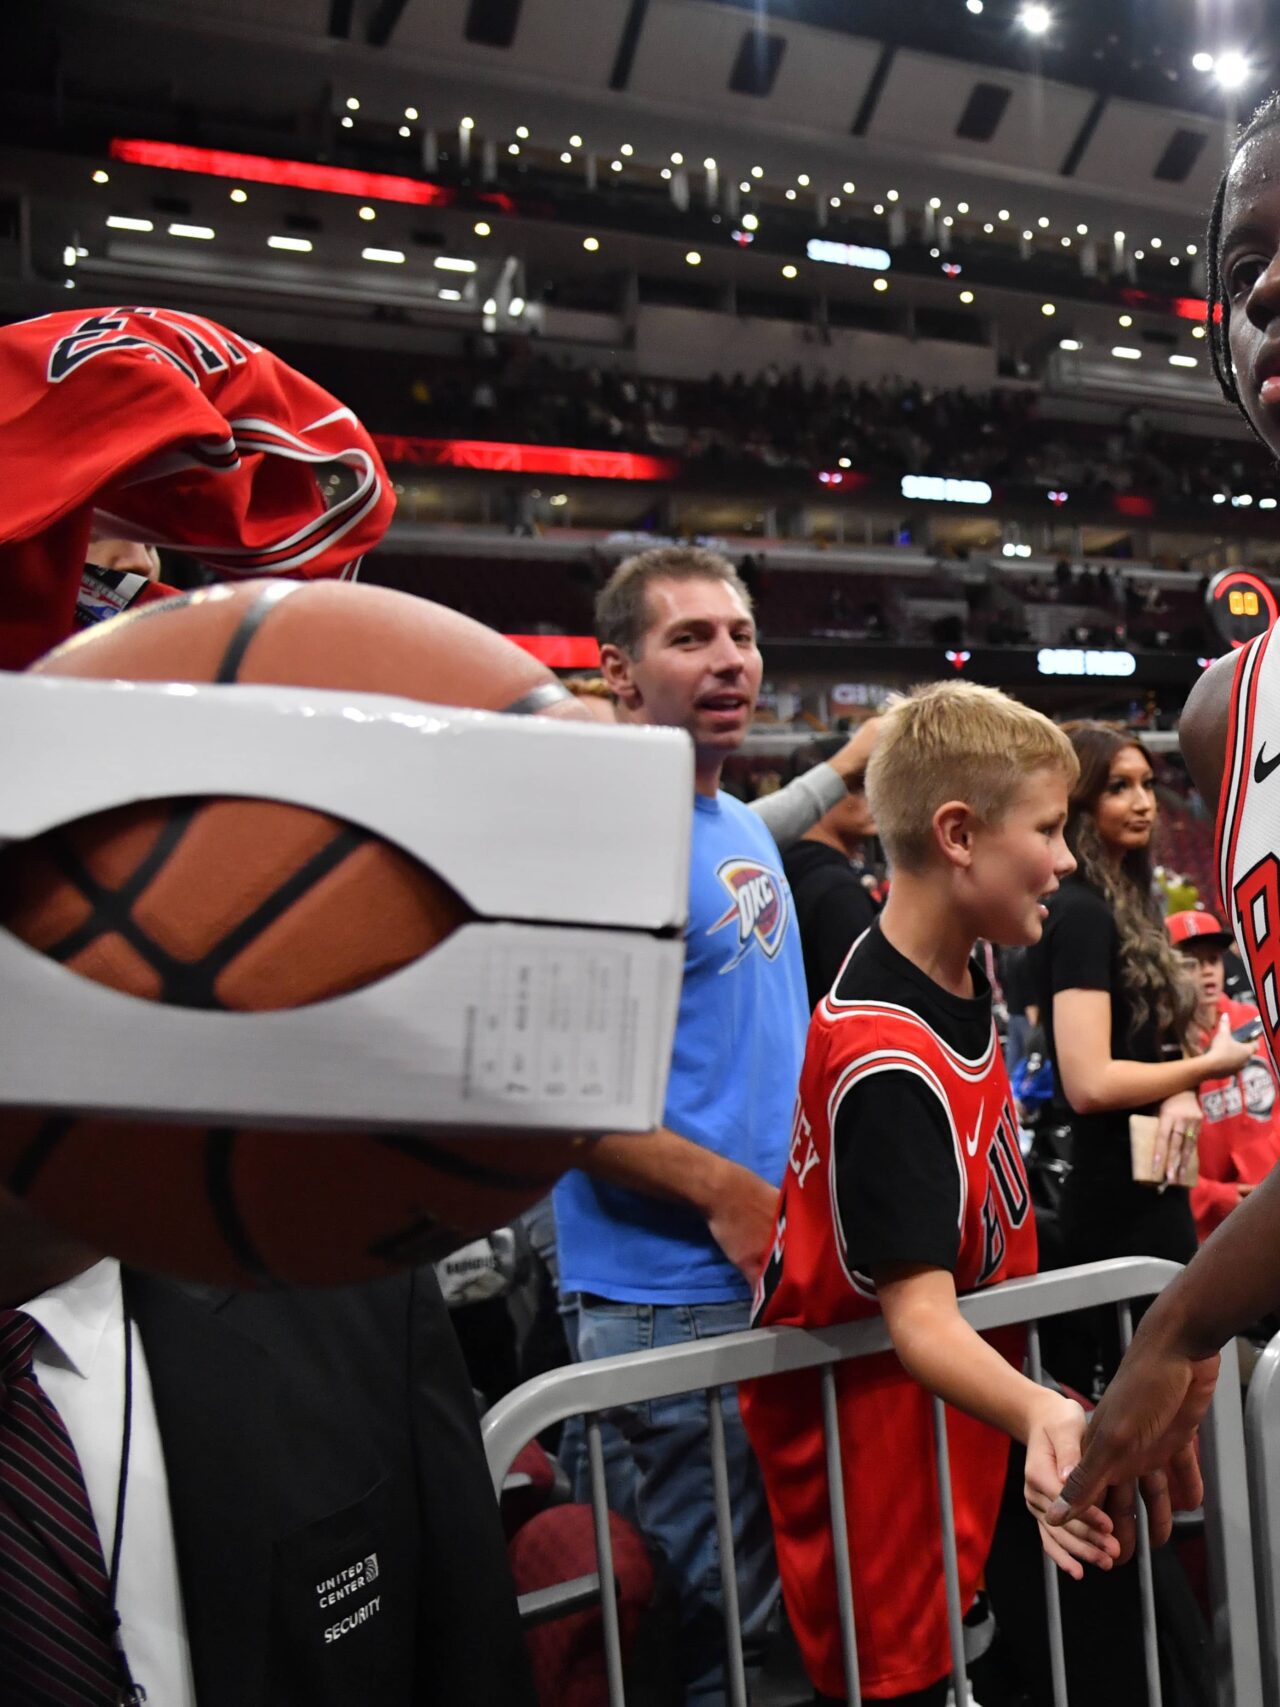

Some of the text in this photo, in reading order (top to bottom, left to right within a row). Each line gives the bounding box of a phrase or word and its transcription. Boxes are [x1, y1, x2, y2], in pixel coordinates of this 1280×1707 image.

[316, 1561, 364, 1594] UNITED
[319, 1576, 366, 1609] CENTER
[323, 1594, 381, 1644] SECURITY
